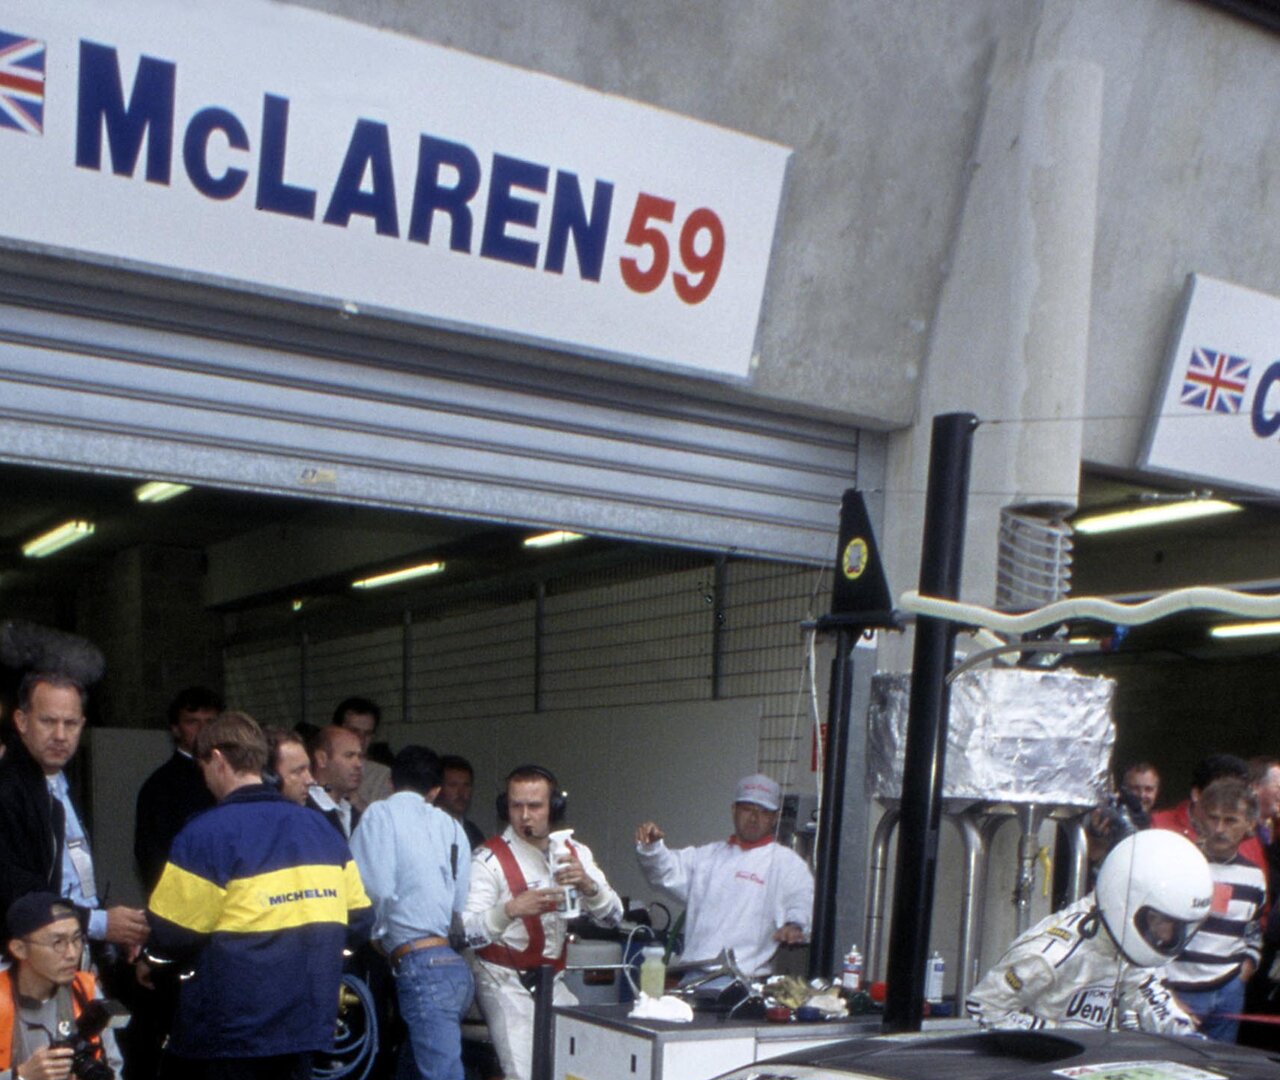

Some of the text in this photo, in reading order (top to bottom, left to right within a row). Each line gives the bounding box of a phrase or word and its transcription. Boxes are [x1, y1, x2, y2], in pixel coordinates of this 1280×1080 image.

[75, 38, 726, 304] McLAREN 59
[268, 888, 337, 905] MICHELIN
